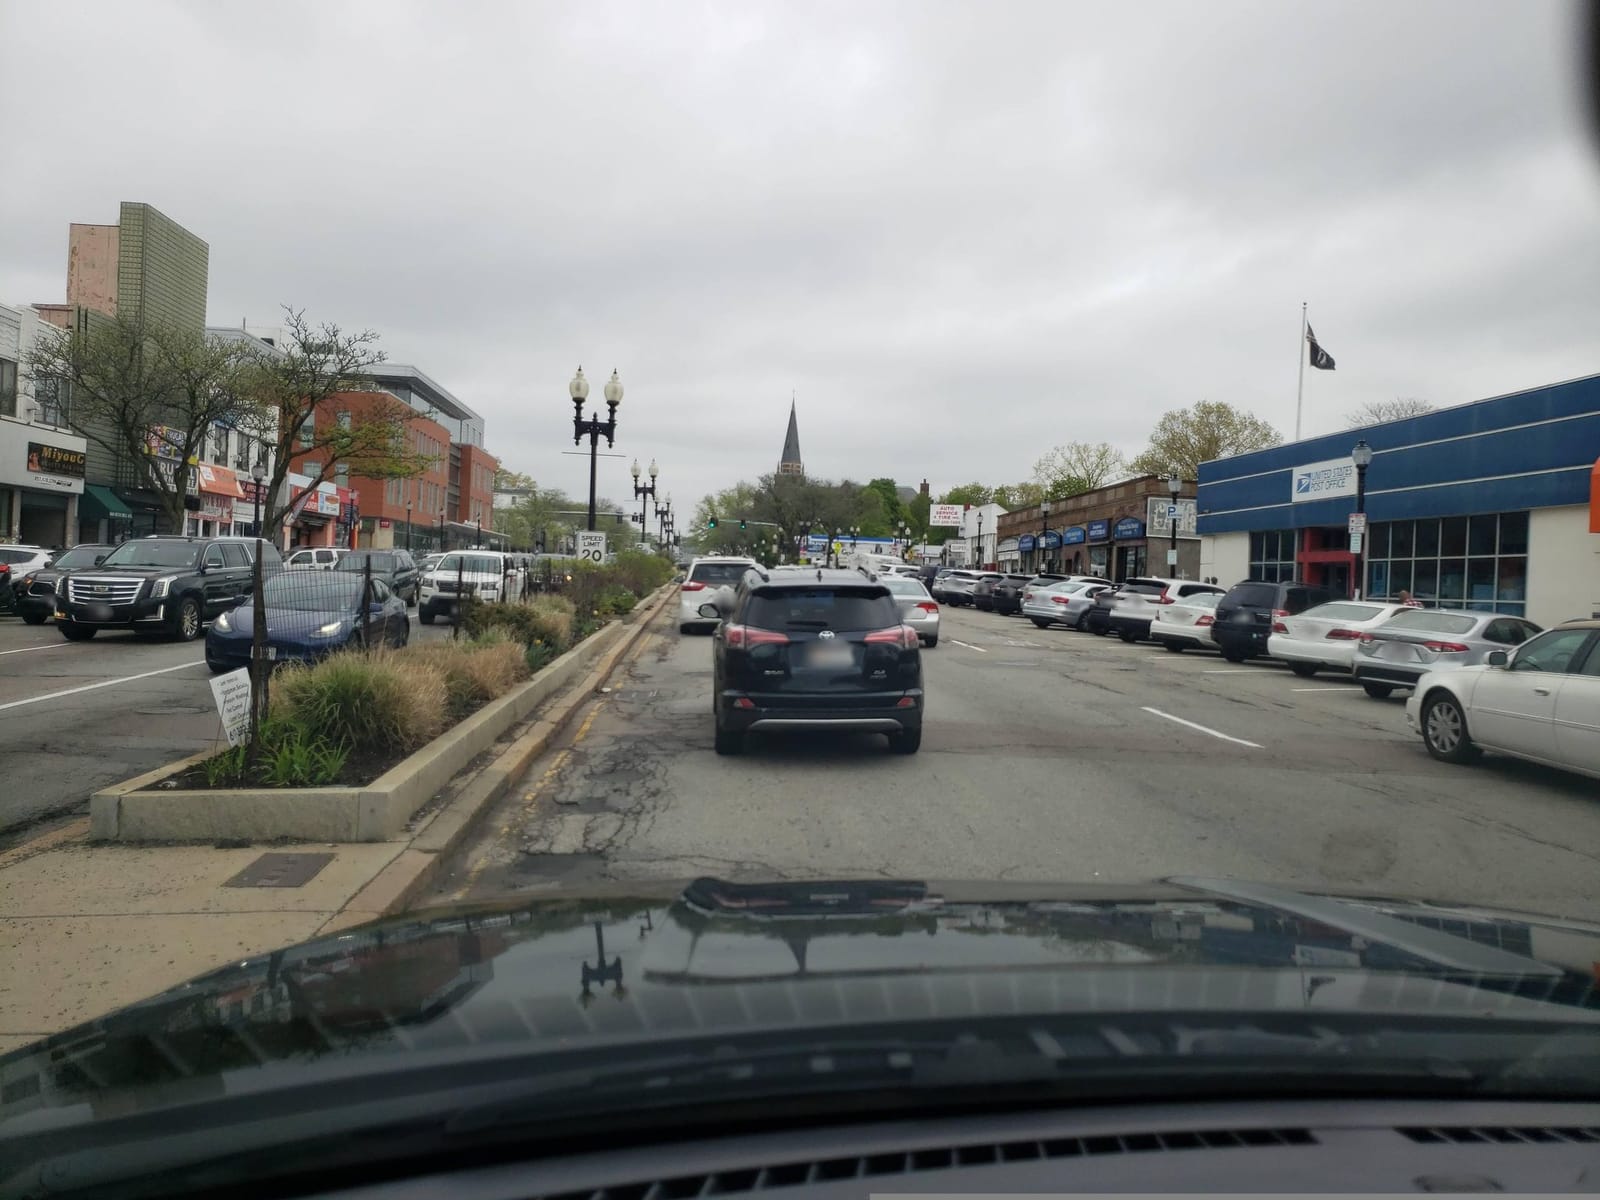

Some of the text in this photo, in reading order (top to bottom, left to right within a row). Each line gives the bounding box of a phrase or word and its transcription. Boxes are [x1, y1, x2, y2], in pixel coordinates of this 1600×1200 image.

[1311, 465, 1352, 480] UNITED STATES
[1311, 477, 1345, 491] POST OFFICE
[582, 549, 602, 561] 20
